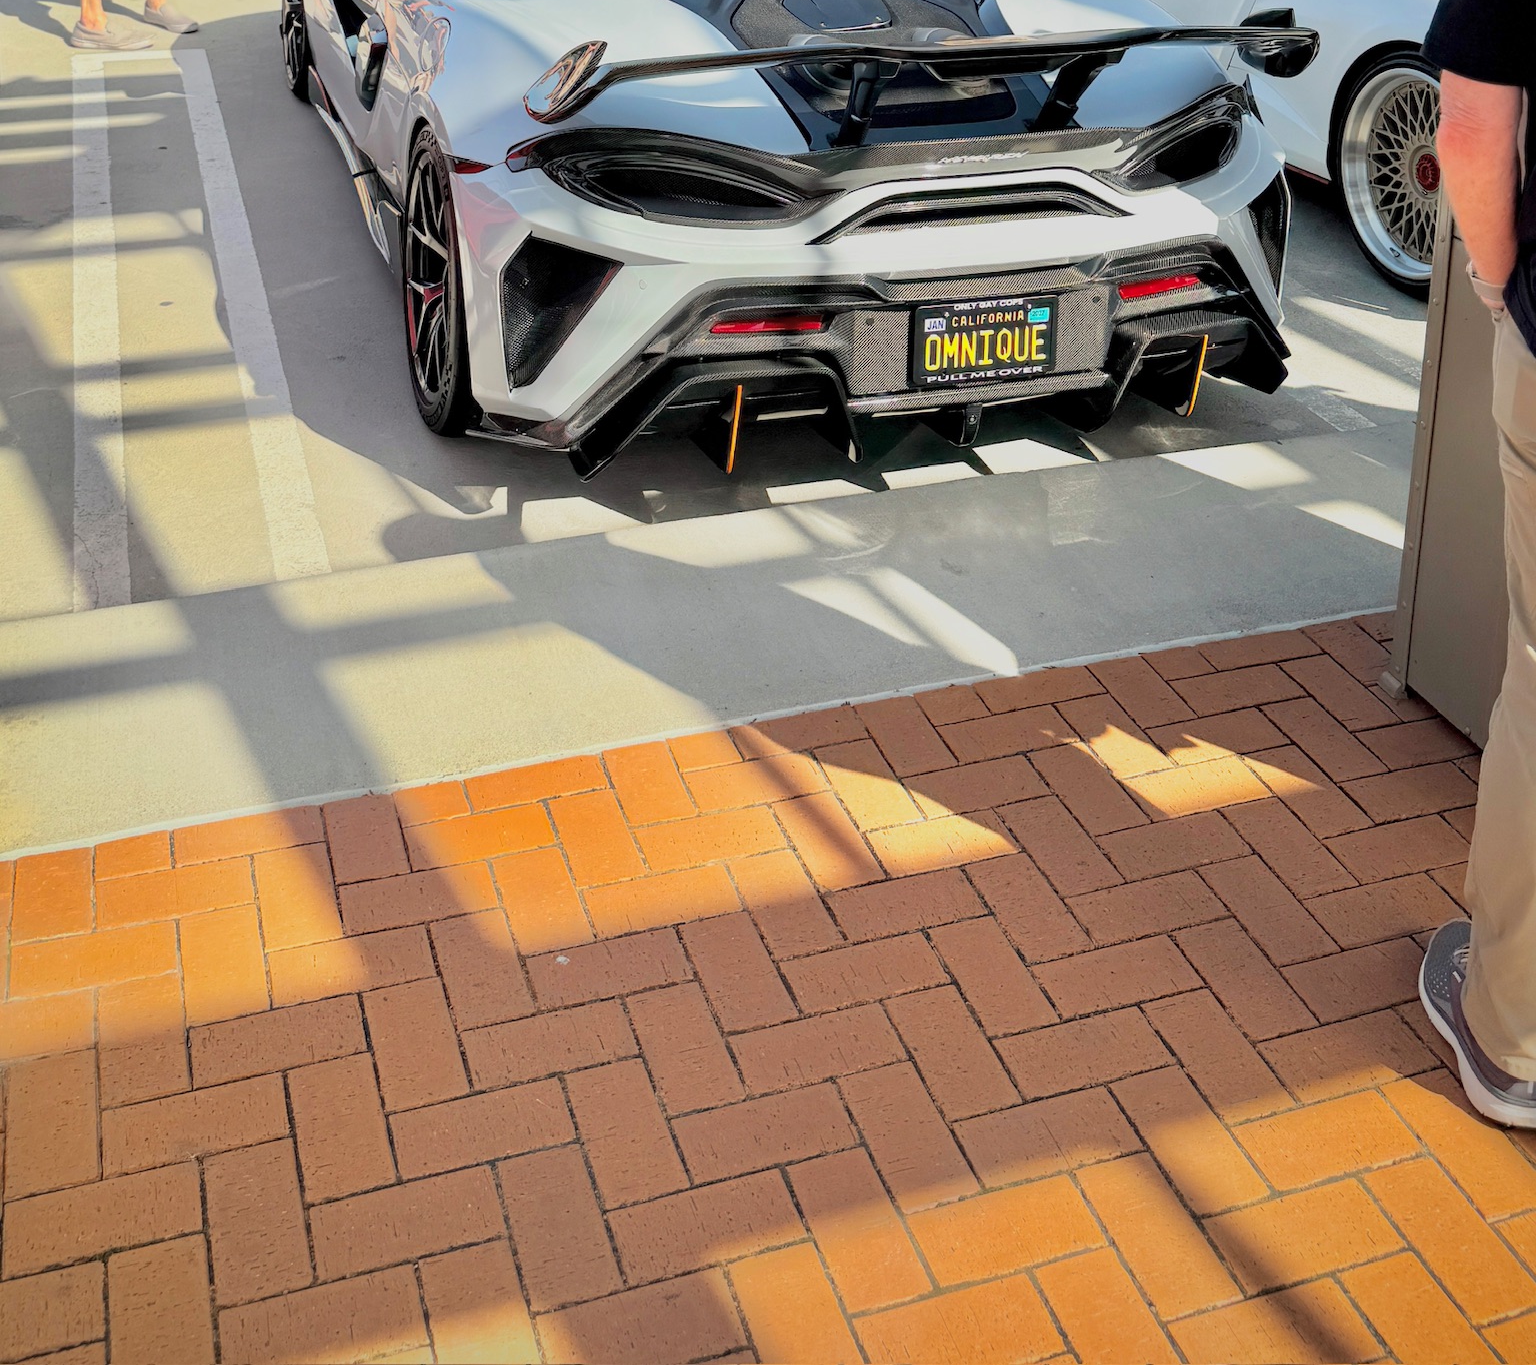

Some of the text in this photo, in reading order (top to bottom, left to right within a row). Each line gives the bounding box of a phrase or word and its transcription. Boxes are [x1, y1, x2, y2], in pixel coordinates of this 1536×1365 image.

[954, 298, 1023, 310] ONLY GAY COPS
[927, 319, 944, 330] JAN
[952, 310, 1024, 327] CALIFORNIA
[924, 324, 1047, 371] OMNIQUE
[926, 366, 1043, 383] PULL ME OVER
